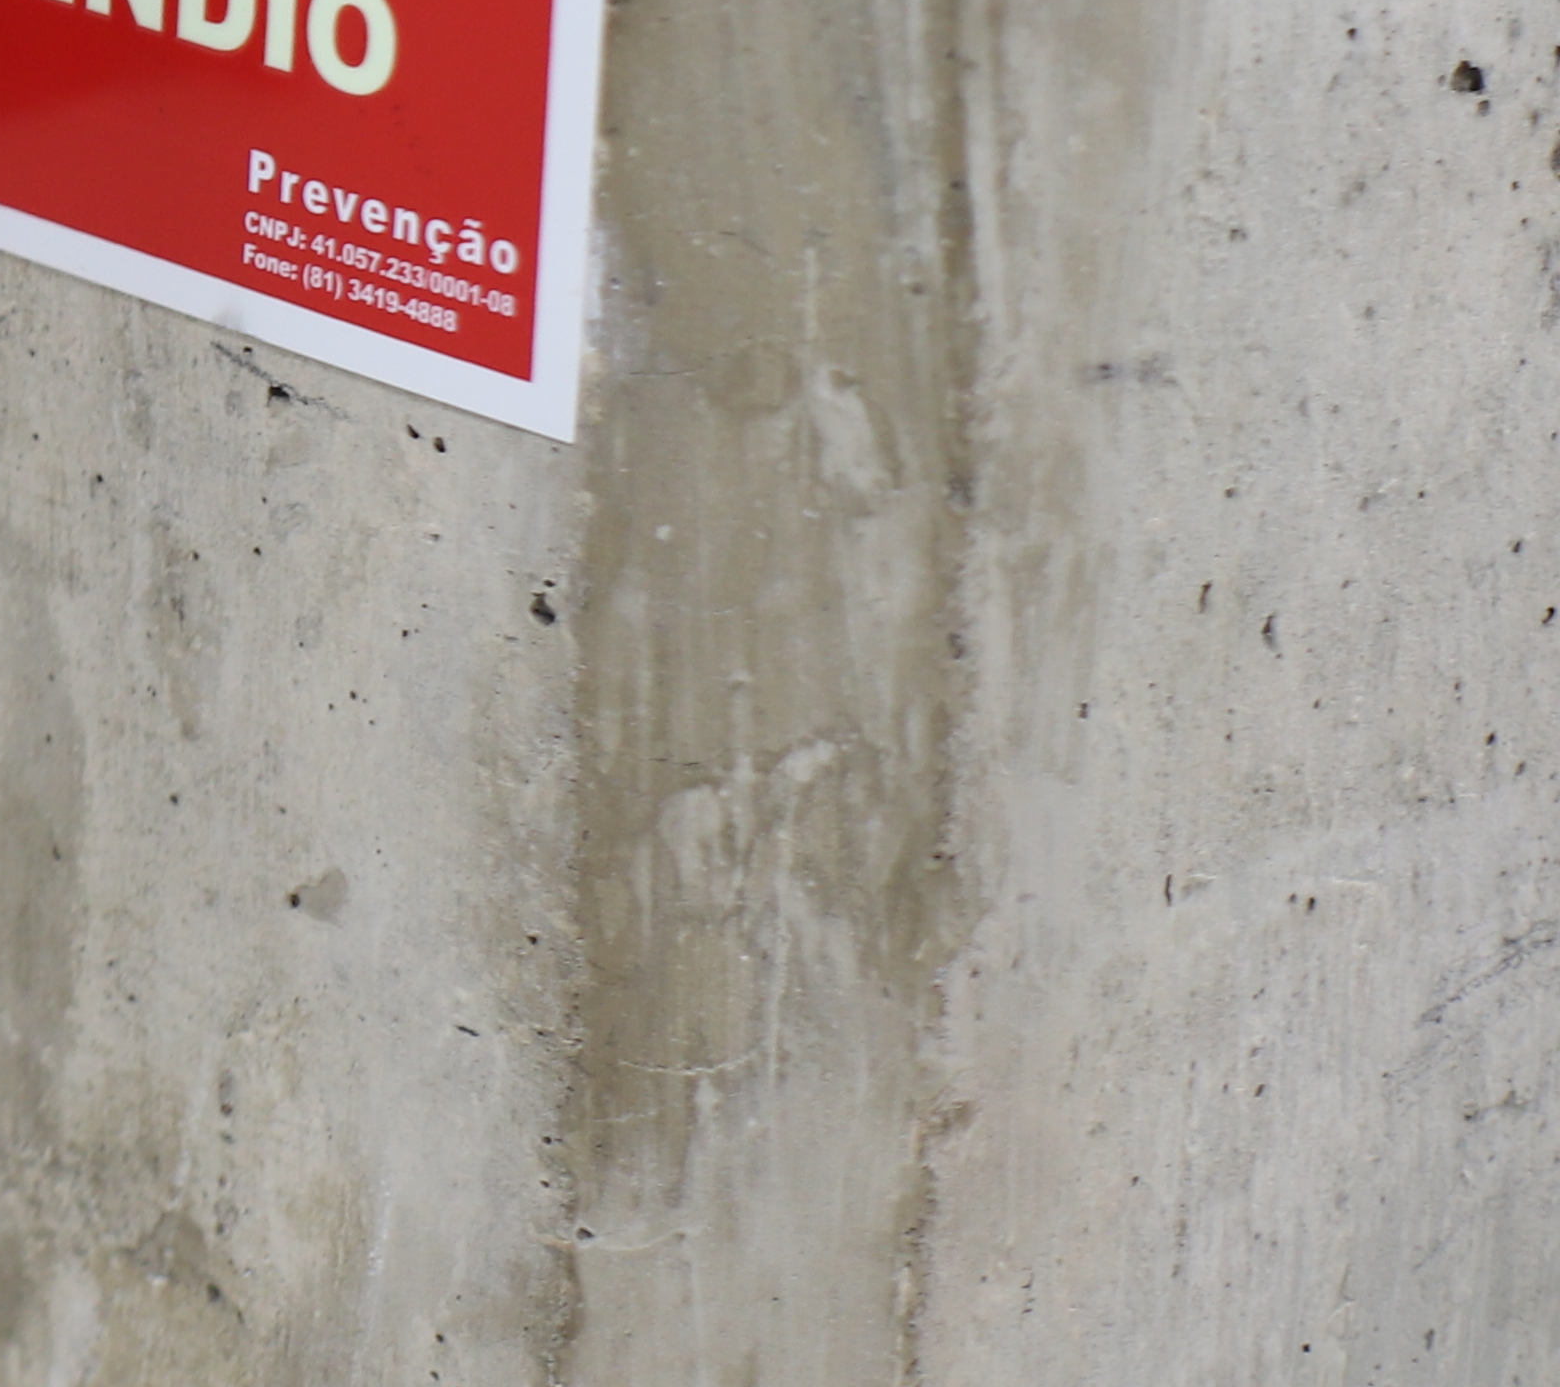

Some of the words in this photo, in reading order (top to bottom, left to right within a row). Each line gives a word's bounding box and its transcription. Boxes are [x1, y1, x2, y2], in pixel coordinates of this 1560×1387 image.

[244, 211, 307, 250] CNPJ:
[247, 148, 520, 275] Prevenção
[242, 242, 298, 280] Fone:
[303, 263, 344, 301] (81)
